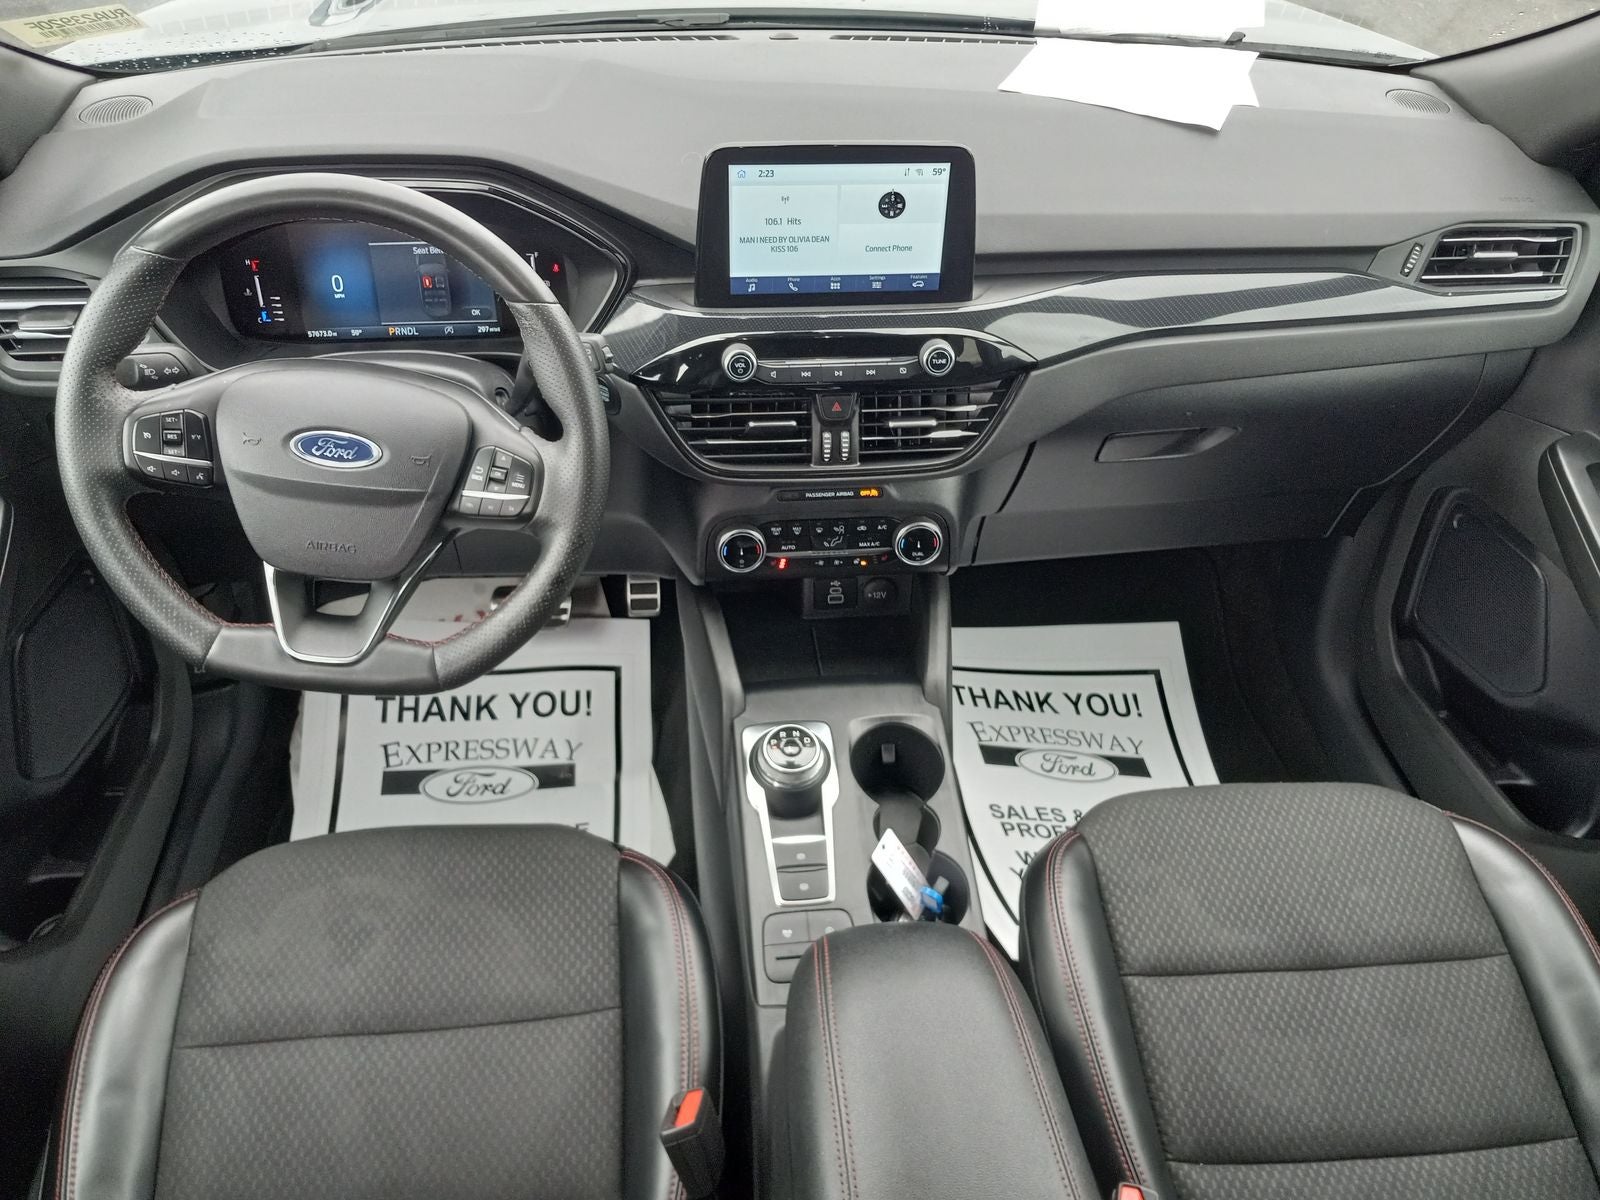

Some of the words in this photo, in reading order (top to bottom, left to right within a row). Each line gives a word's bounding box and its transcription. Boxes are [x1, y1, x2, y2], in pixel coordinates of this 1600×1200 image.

[758, 170, 774, 178] 2:23
[765, 217, 783, 226] 106.1
[787, 217, 802, 226] Hits
[739, 236, 756, 244] MAN
[779, 235, 788, 243] BY
[788, 235, 811, 243] OLIVIA
[811, 235, 830, 243] DEAN
[771, 245, 786, 253] KISS
[786, 245, 798, 253] 106
[865, 244, 891, 253] Connect
[892, 244, 913, 252] Phone
[413, 246, 429, 255] Seat
[331, 275, 344, 293] 0
[312, 437, 359, 460] Ford
[305, 538, 357, 554] AIRBAG
[375, 693, 499, 723] THANK
[509, 690, 593, 718] YOU!
[952, 685, 1060, 715] THANK
[1063, 692, 1143, 718] YOU!
[968, 721, 1144, 755] EXPRESSWAY
[380, 737, 583, 768] EXPRESSWAY
[1040, 751, 1096, 777] Ford
[445, 771, 512, 798] Ford
[989, 803, 1067, 823] SALES
